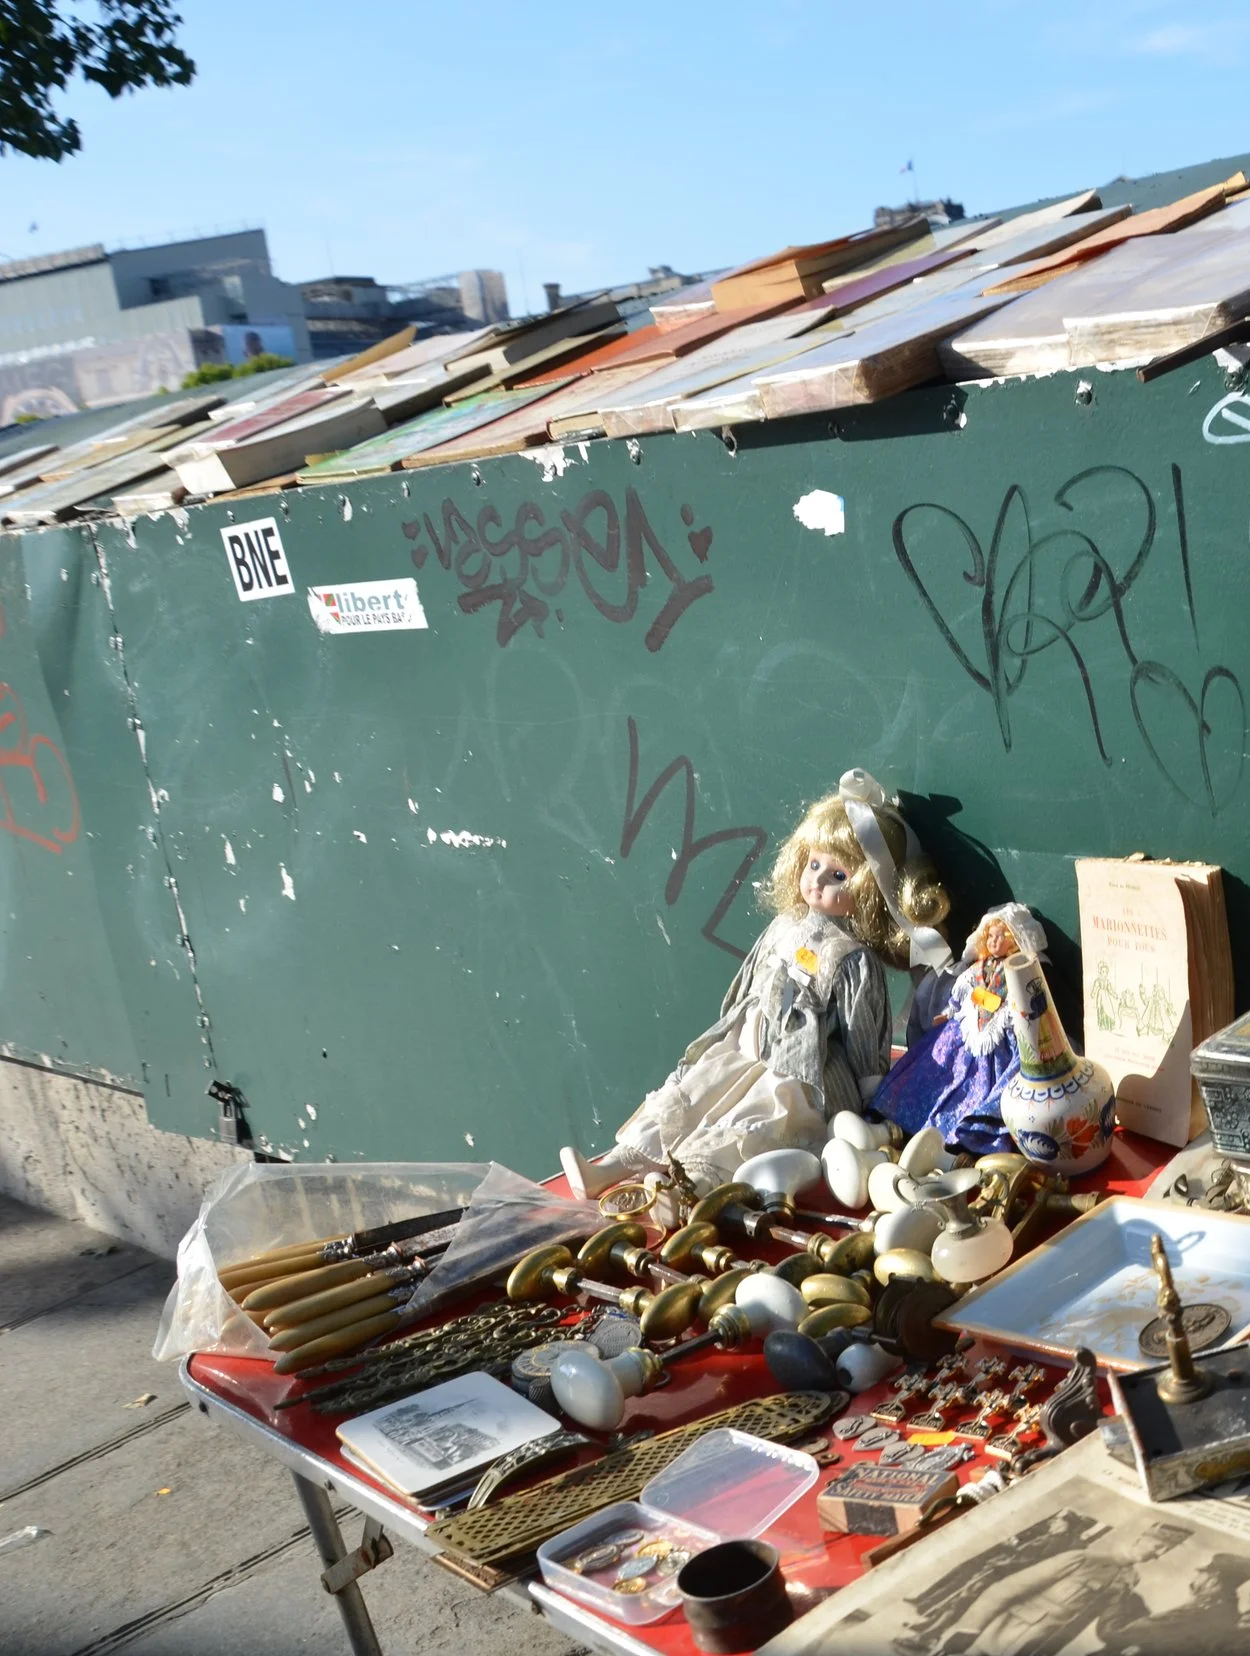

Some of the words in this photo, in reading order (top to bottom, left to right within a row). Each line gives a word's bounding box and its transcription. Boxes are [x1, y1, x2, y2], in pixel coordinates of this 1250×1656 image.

[228, 527, 289, 592] BNE
[335, 589, 409, 613] libert
[341, 614, 361, 626] POUR
[361, 613, 371, 625] LE
[372, 612, 390, 624] PAYS
[1092, 915, 1168, 941] MARIONNETTES
[1107, 935, 1130, 950] POUR
[855, 1467, 941, 1486] NATIONAL
